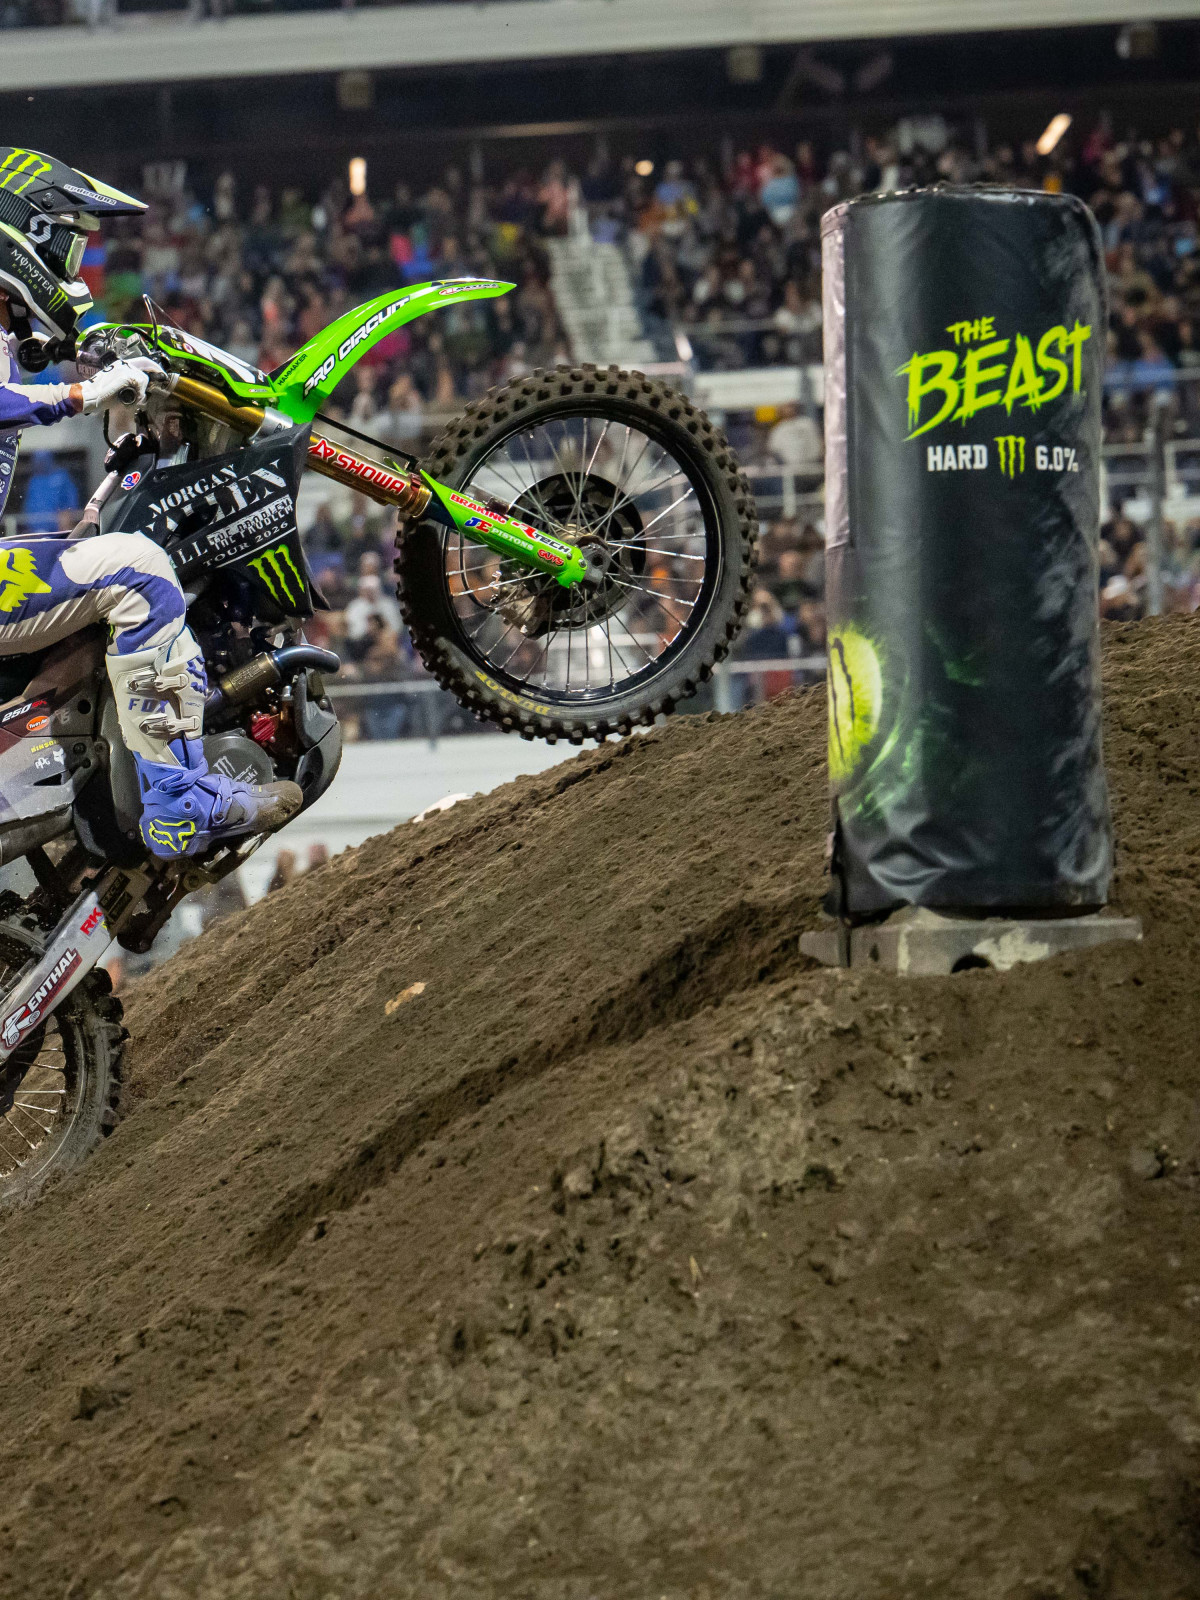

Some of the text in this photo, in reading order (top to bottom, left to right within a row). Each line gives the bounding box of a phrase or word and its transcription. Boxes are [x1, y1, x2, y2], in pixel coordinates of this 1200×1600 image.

[11, 249, 55, 295] MONSTER
[946, 317, 997, 345] THE
[303, 354, 335, 400] PRO
[338, 296, 410, 361] CIRCUIT
[277, 354, 308, 386] HAMMAKER
[895, 319, 1092, 441] BEAST
[334, 452, 408, 495] SHOWA
[927, 444, 1079, 472] HARD 6.0%
[147, 463, 238, 519] MORGAN
[449, 492, 507, 525] BRAKING
[203, 521, 289, 568] TOUR 2026
[464, 516, 534, 551] JE PISTONS
[538, 548, 564, 566] GUTS
[128, 697, 170, 713] FOX
[29, 720, 41, 729] Twin
[35, 757, 51, 769] PPG
[80, 907, 104, 935] RK
[1, 951, 77, 1047] RENTHAL
